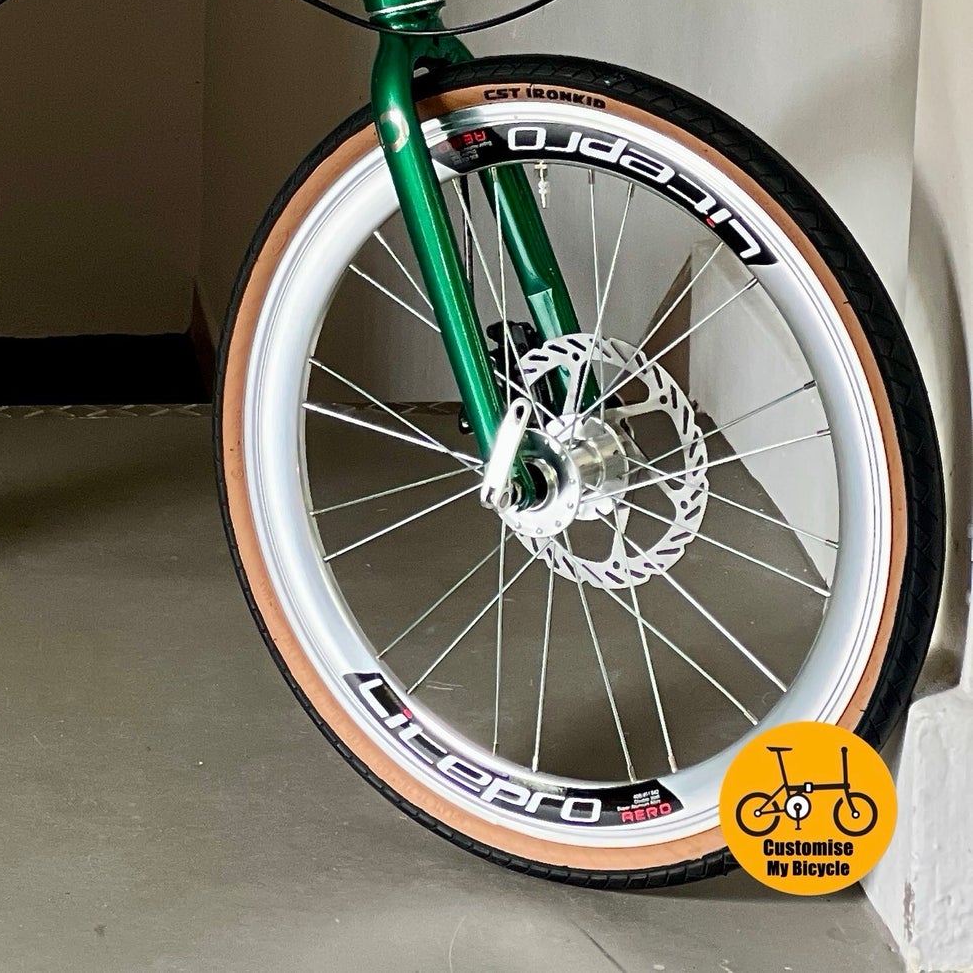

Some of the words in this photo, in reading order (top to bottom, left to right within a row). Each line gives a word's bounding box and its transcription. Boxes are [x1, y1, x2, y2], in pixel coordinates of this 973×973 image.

[483, 87, 520, 101] CST
[525, 87, 606, 109] IRONKID
[621, 802, 672, 823] AERO
